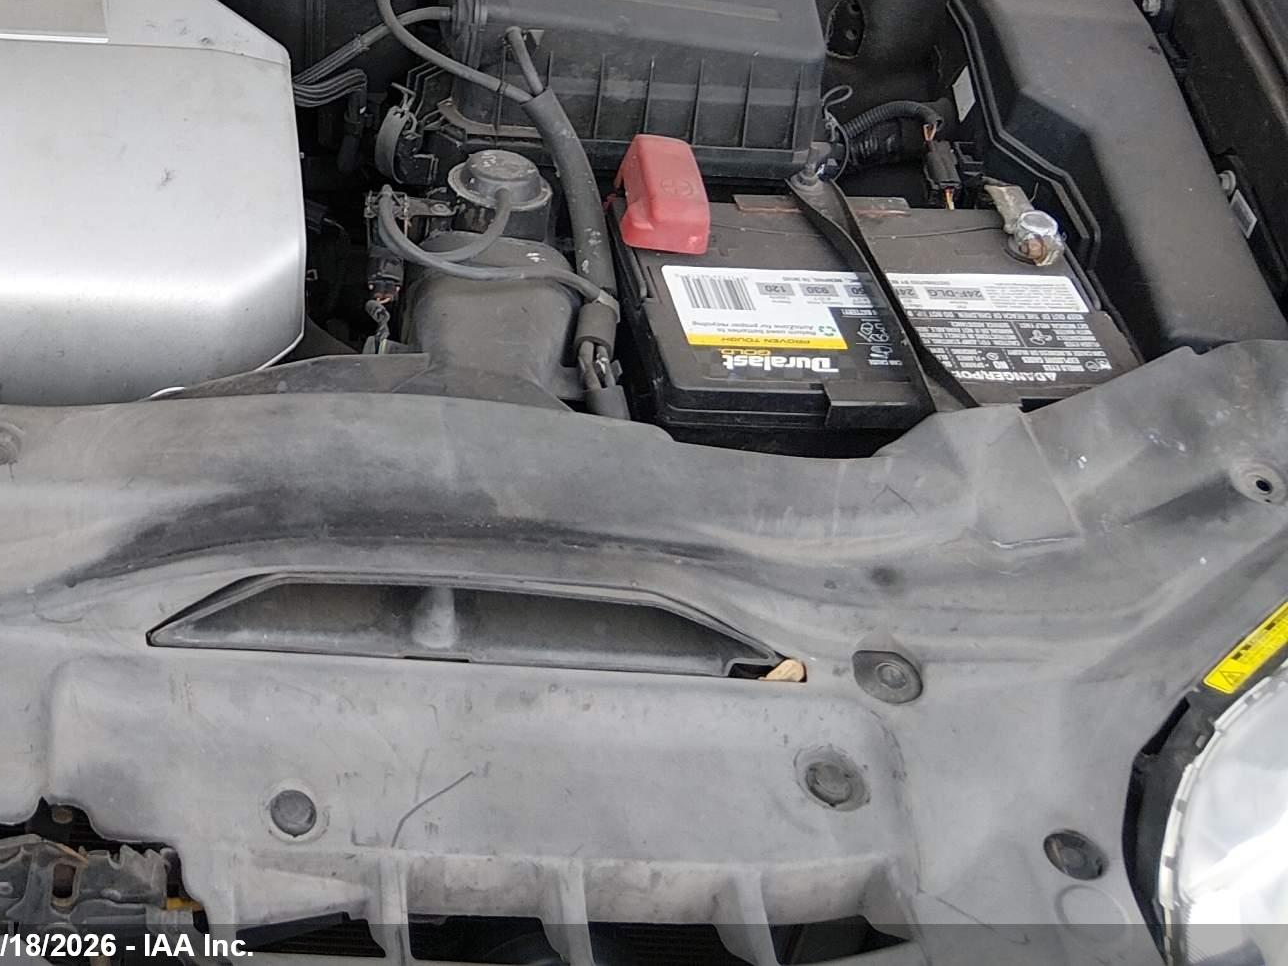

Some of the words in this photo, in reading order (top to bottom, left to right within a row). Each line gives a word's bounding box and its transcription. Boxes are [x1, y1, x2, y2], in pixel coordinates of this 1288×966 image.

[765, 284, 787, 293] 120
[927, 289, 983, 298] 24F-DLG
[720, 355, 839, 373] Duralast
